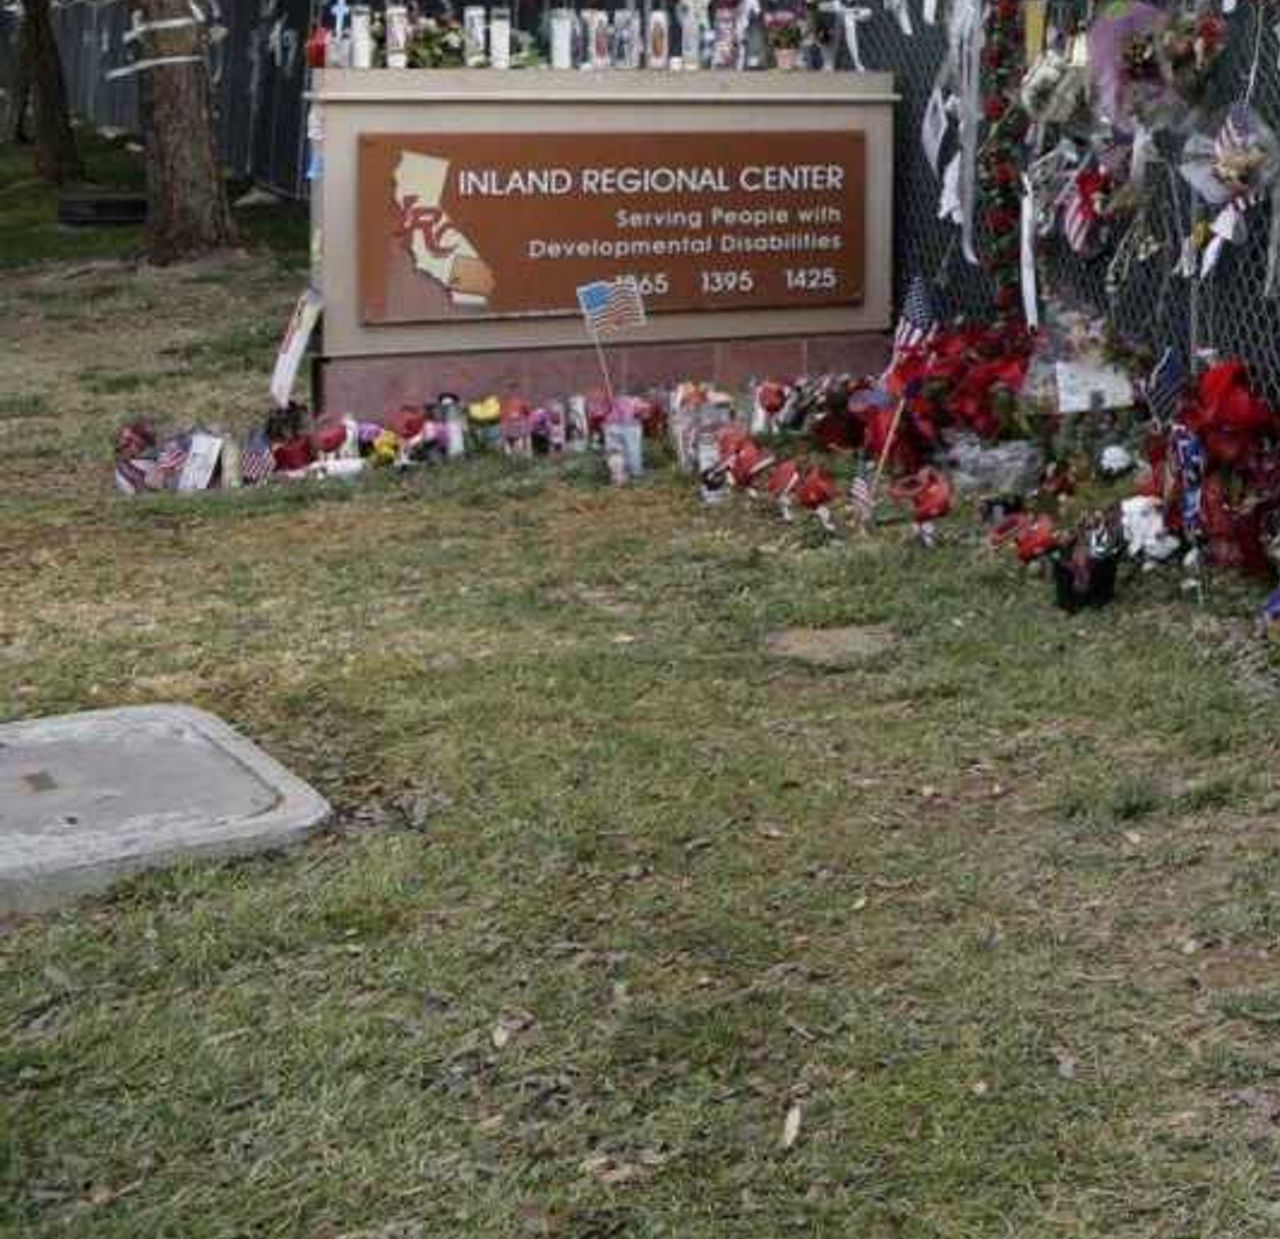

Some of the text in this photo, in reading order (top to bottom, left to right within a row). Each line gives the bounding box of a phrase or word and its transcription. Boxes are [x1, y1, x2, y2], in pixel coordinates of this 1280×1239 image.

[458, 164, 844, 195] INLAND REGIONAL CENTER
[616, 207, 842, 229] Serving People with
[528, 232, 843, 259] Developmental Disabilities
[700, 270, 754, 294] 1395
[785, 267, 837, 290] 1425
